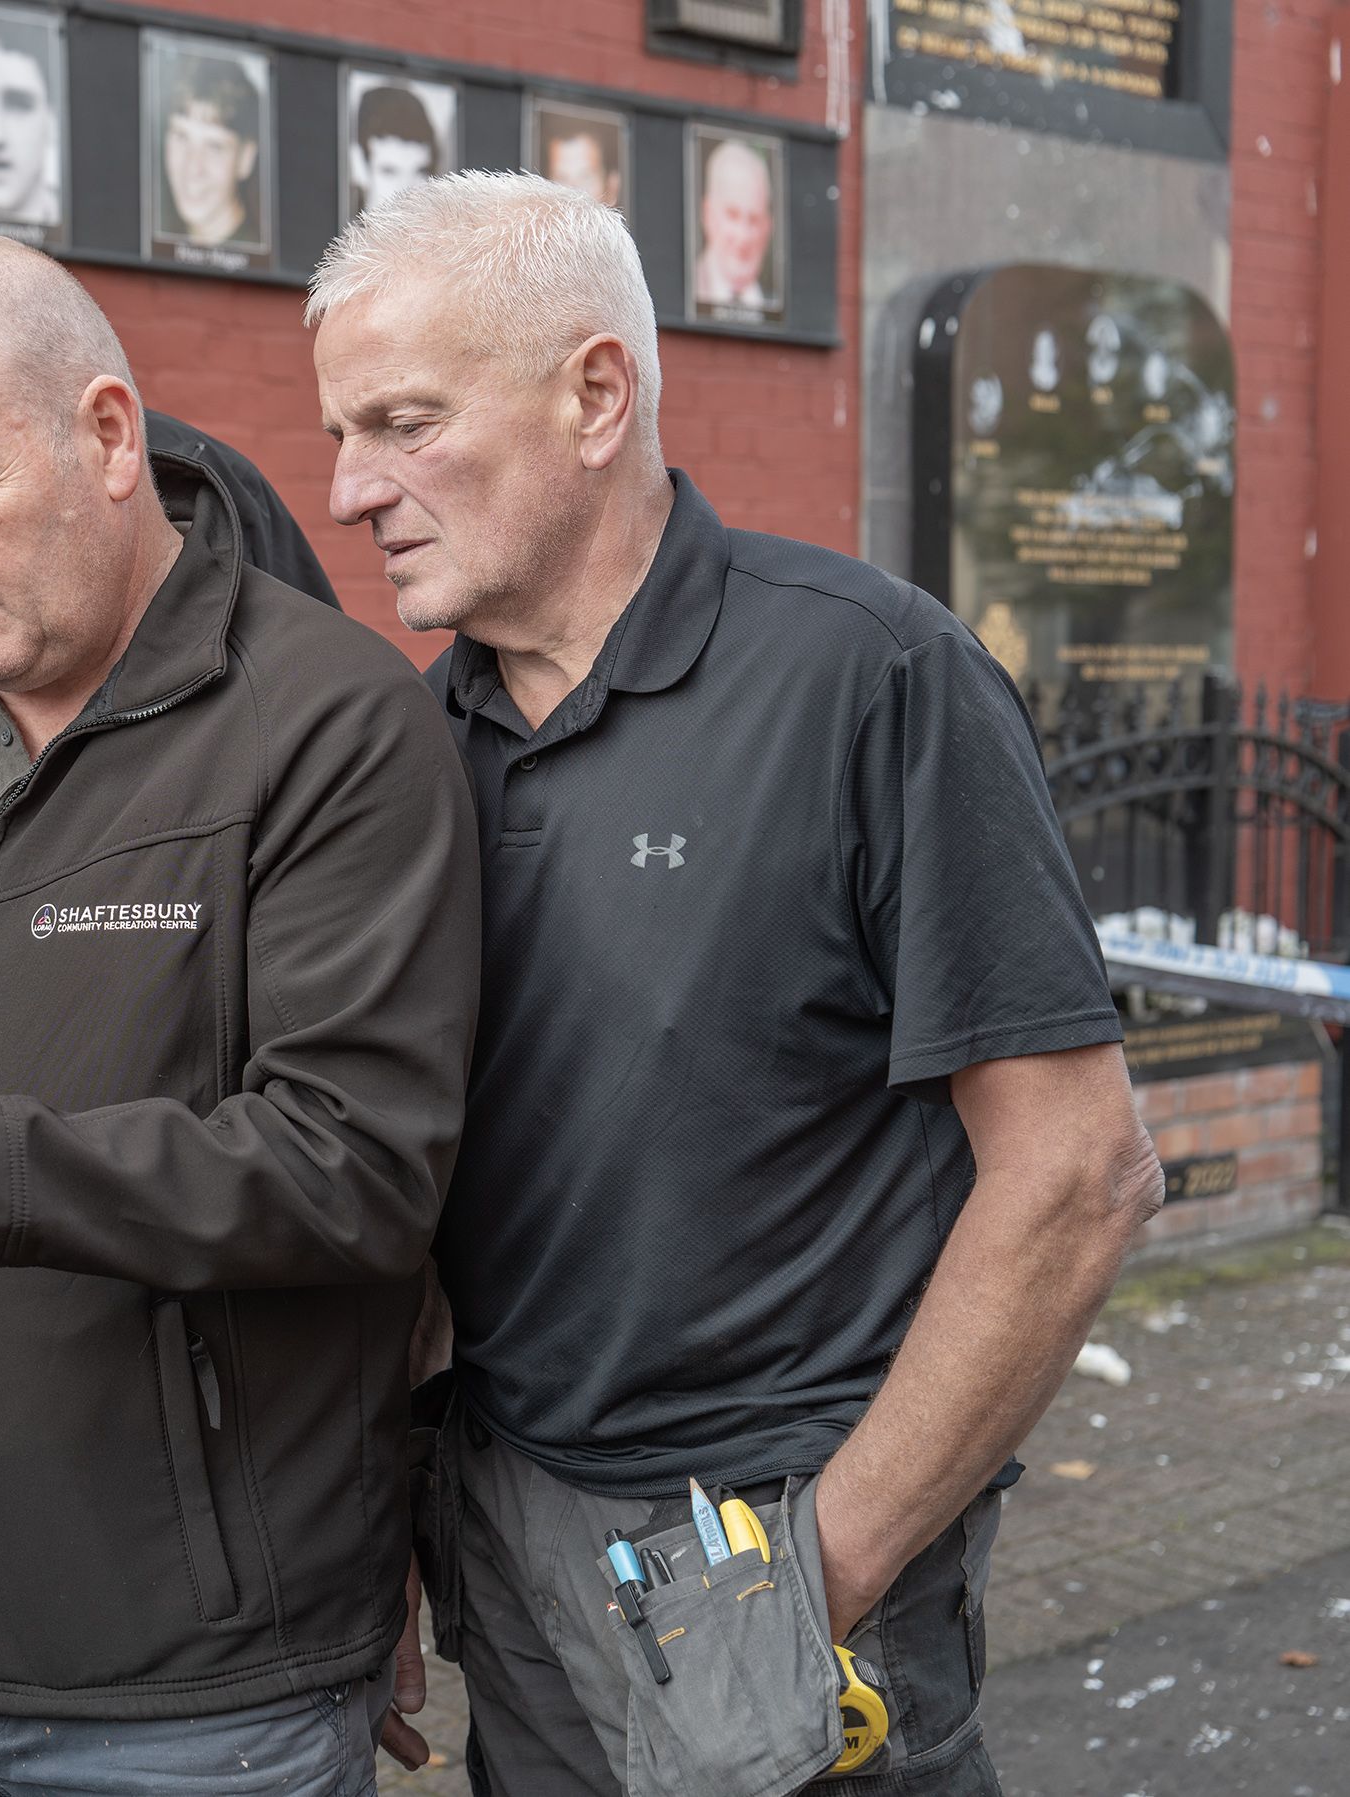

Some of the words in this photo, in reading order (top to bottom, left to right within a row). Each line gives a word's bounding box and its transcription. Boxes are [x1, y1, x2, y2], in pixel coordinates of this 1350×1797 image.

[58, 903, 202, 923] SHAFTESBURY
[57, 921, 102, 933] COMMUNITY
[103, 920, 158, 931] RECREATION
[159, 920, 198, 930] CENTRE
